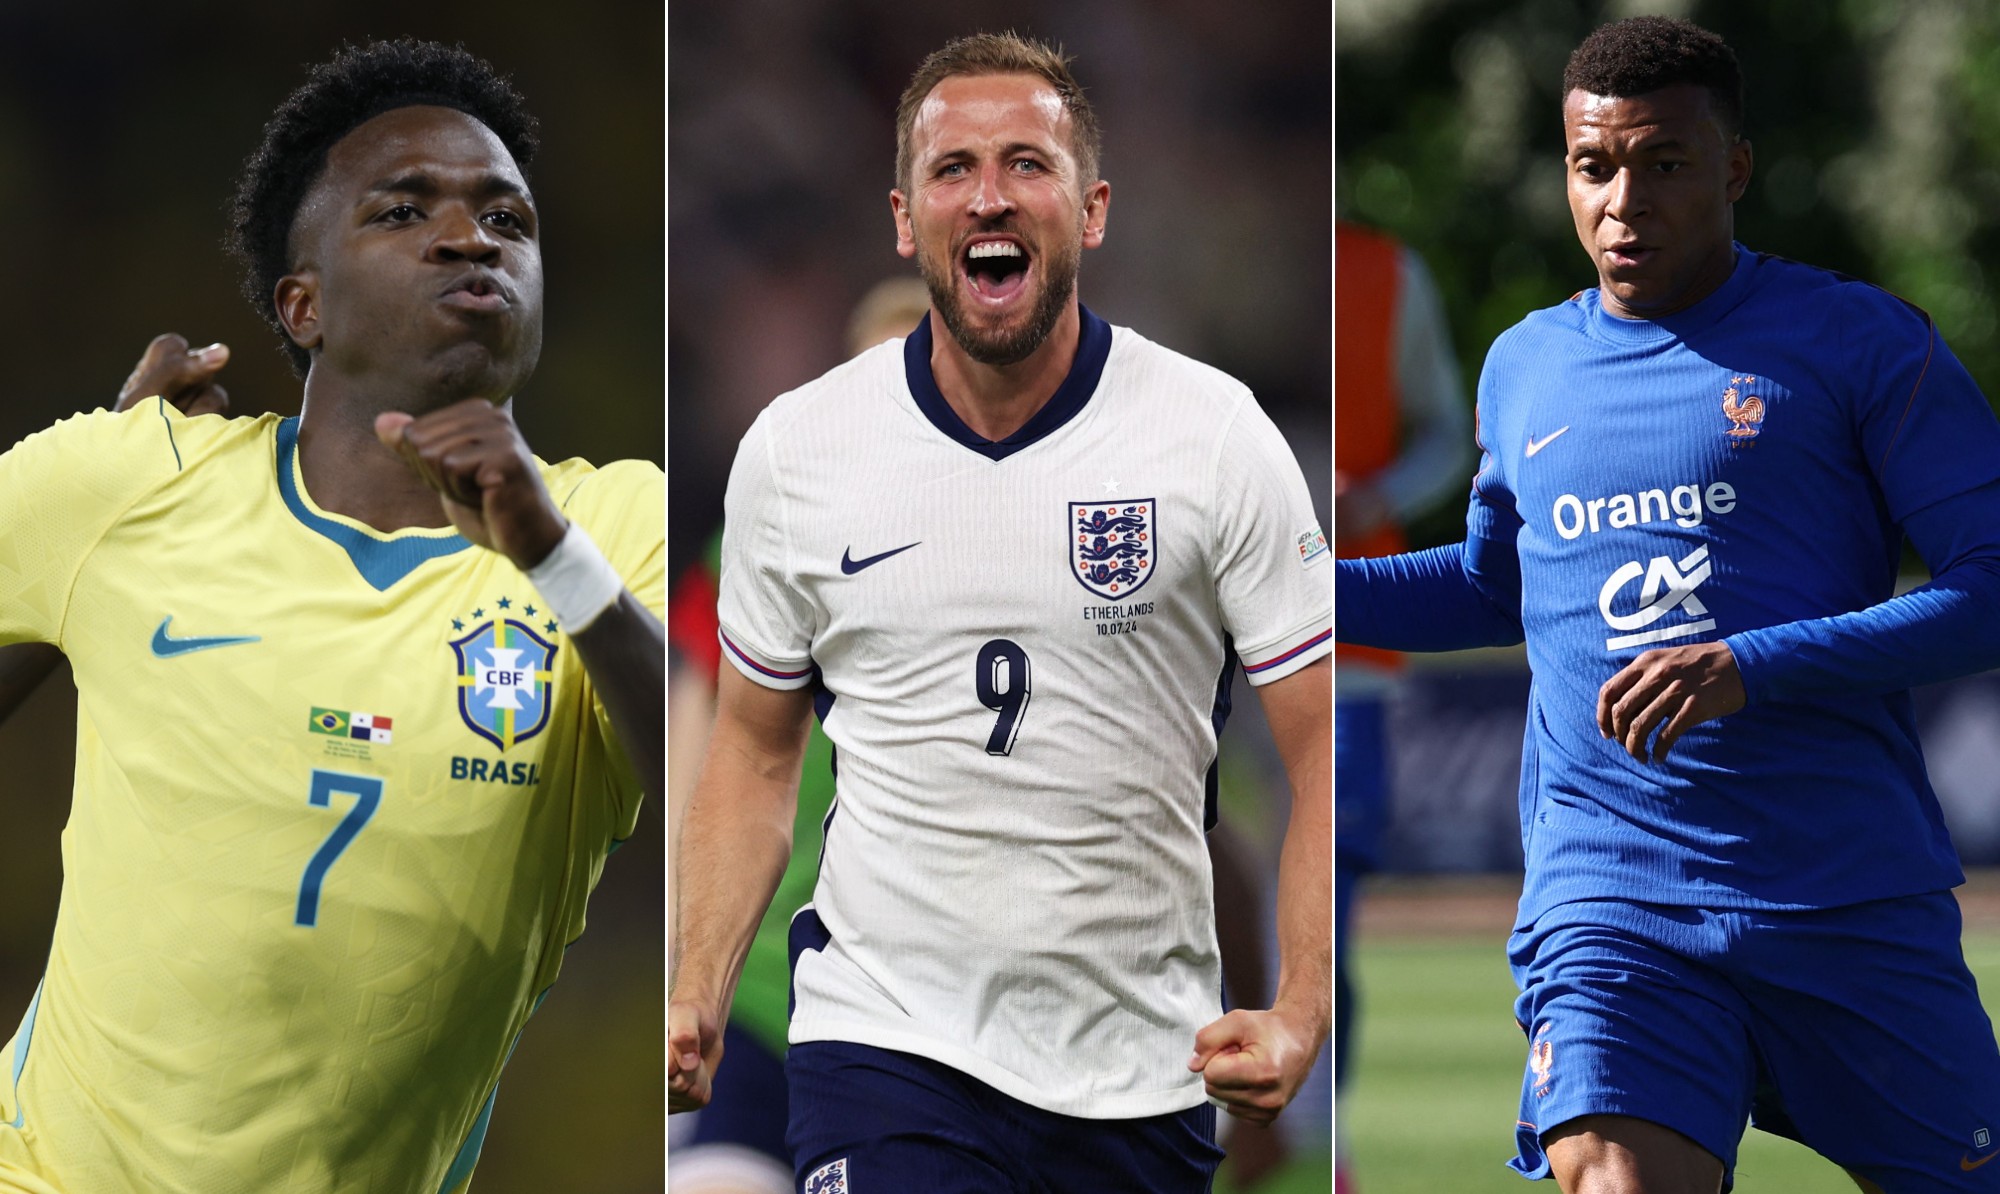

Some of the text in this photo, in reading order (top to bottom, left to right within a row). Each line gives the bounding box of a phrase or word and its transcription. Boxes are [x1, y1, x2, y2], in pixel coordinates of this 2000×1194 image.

[1552, 481, 1737, 540] Orange
[1083, 602, 1154, 620] ETHERLANDS
[1096, 621, 1137, 636] 10.07.24
[486, 670, 524, 686] CBF
[976, 639, 1031, 756] 9
[294, 768, 384, 928] 7
